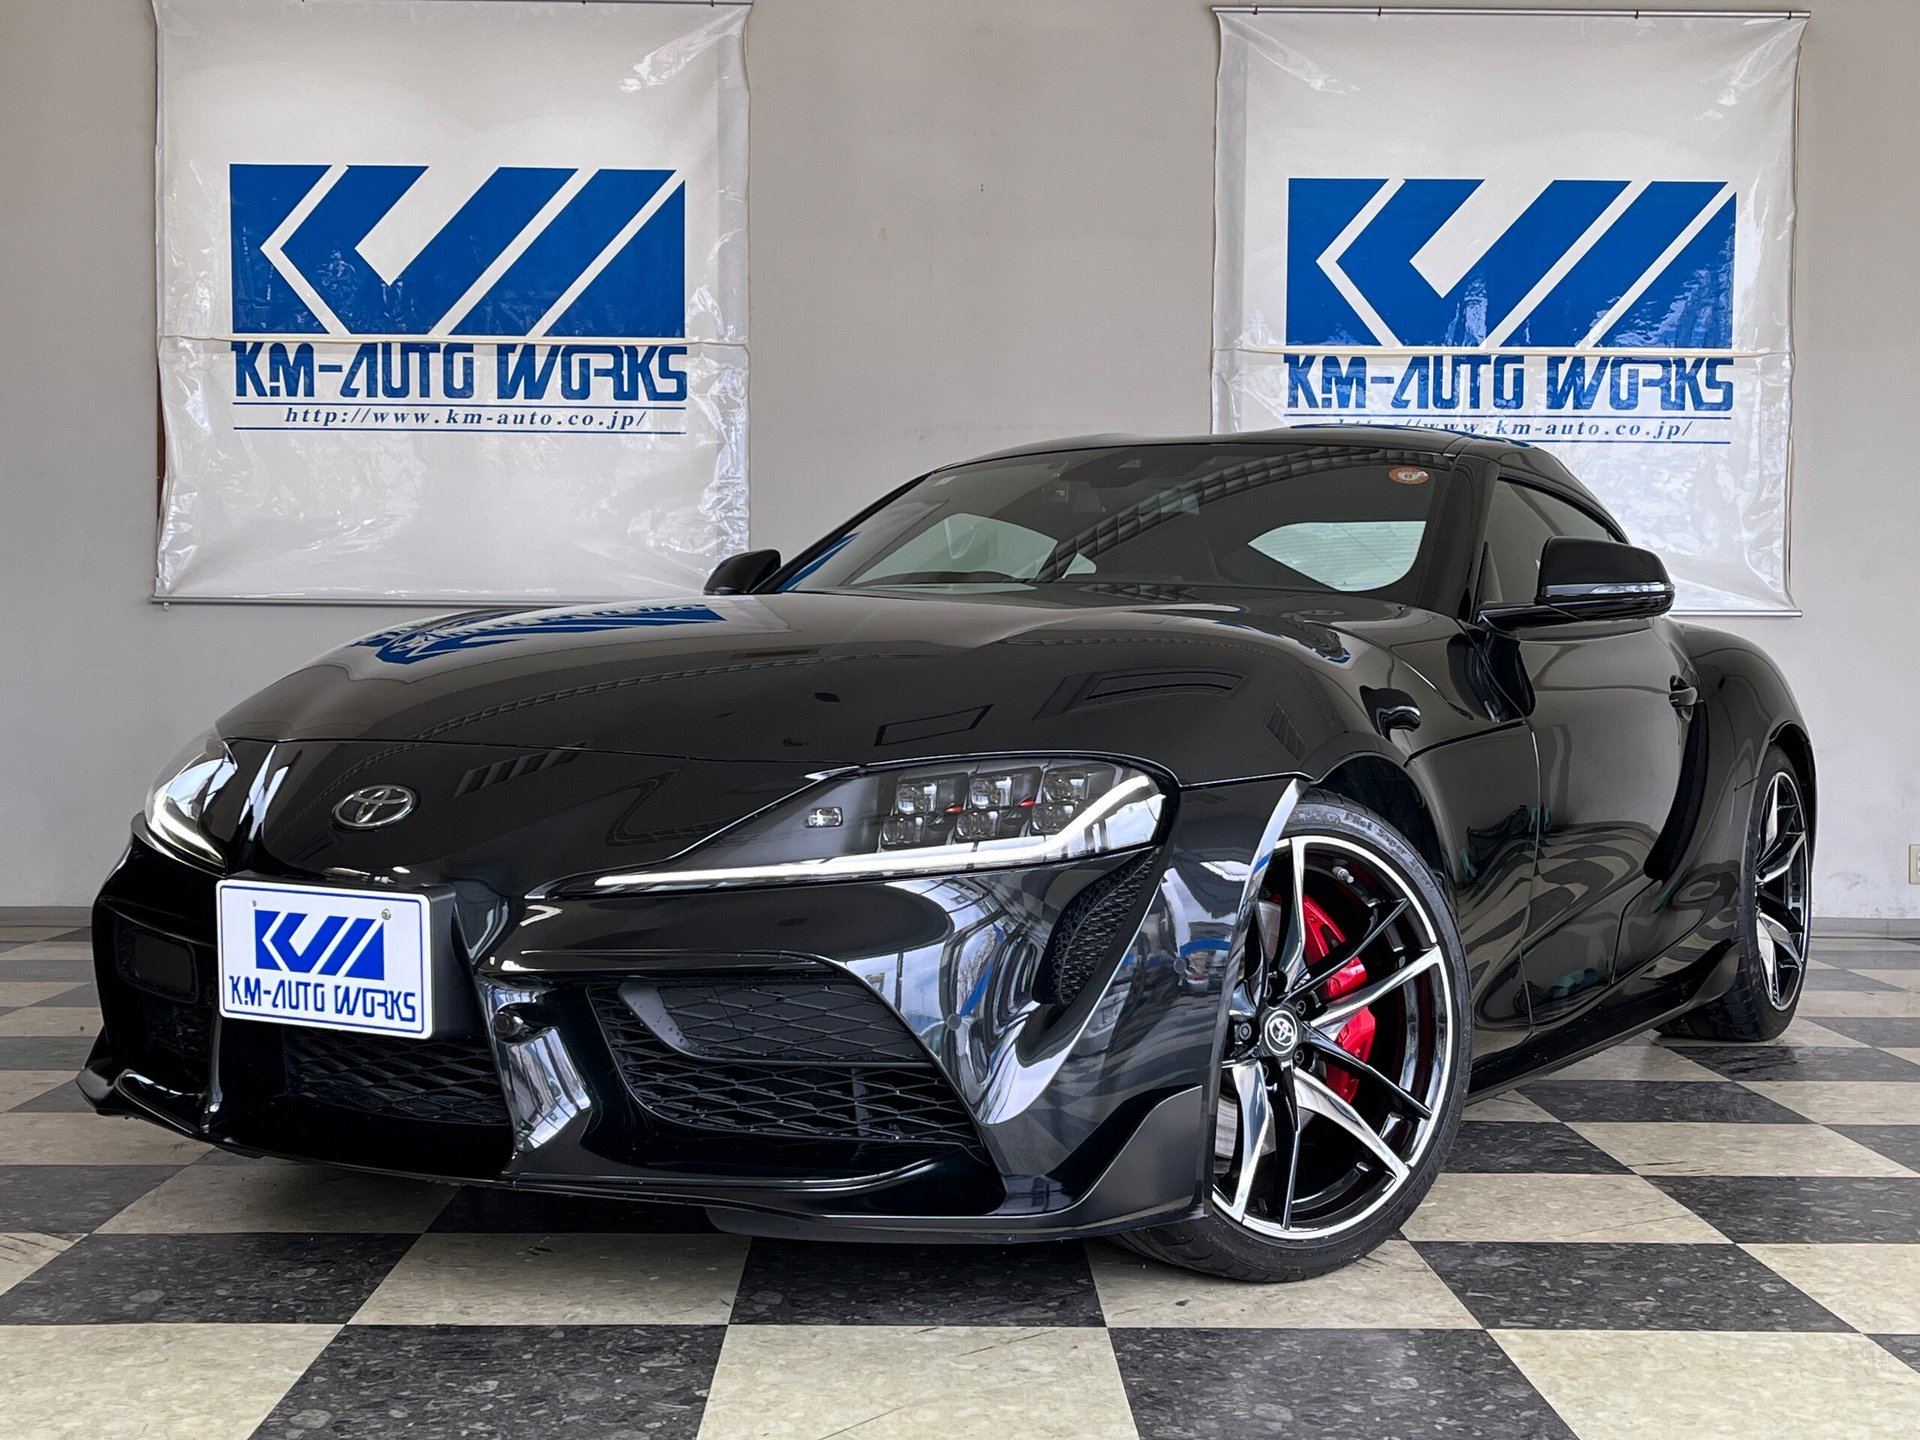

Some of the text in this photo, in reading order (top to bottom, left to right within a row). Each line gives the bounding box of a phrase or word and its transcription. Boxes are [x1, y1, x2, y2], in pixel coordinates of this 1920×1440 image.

[230, 342, 687, 402] KM-AUTO WORKS
[1284, 355, 1734, 411] KM-AUTO WORKS
[285, 407, 646, 430] http://www.km-auto.co.jp/
[229, 975, 416, 1023] KM-AUTO WORKS
